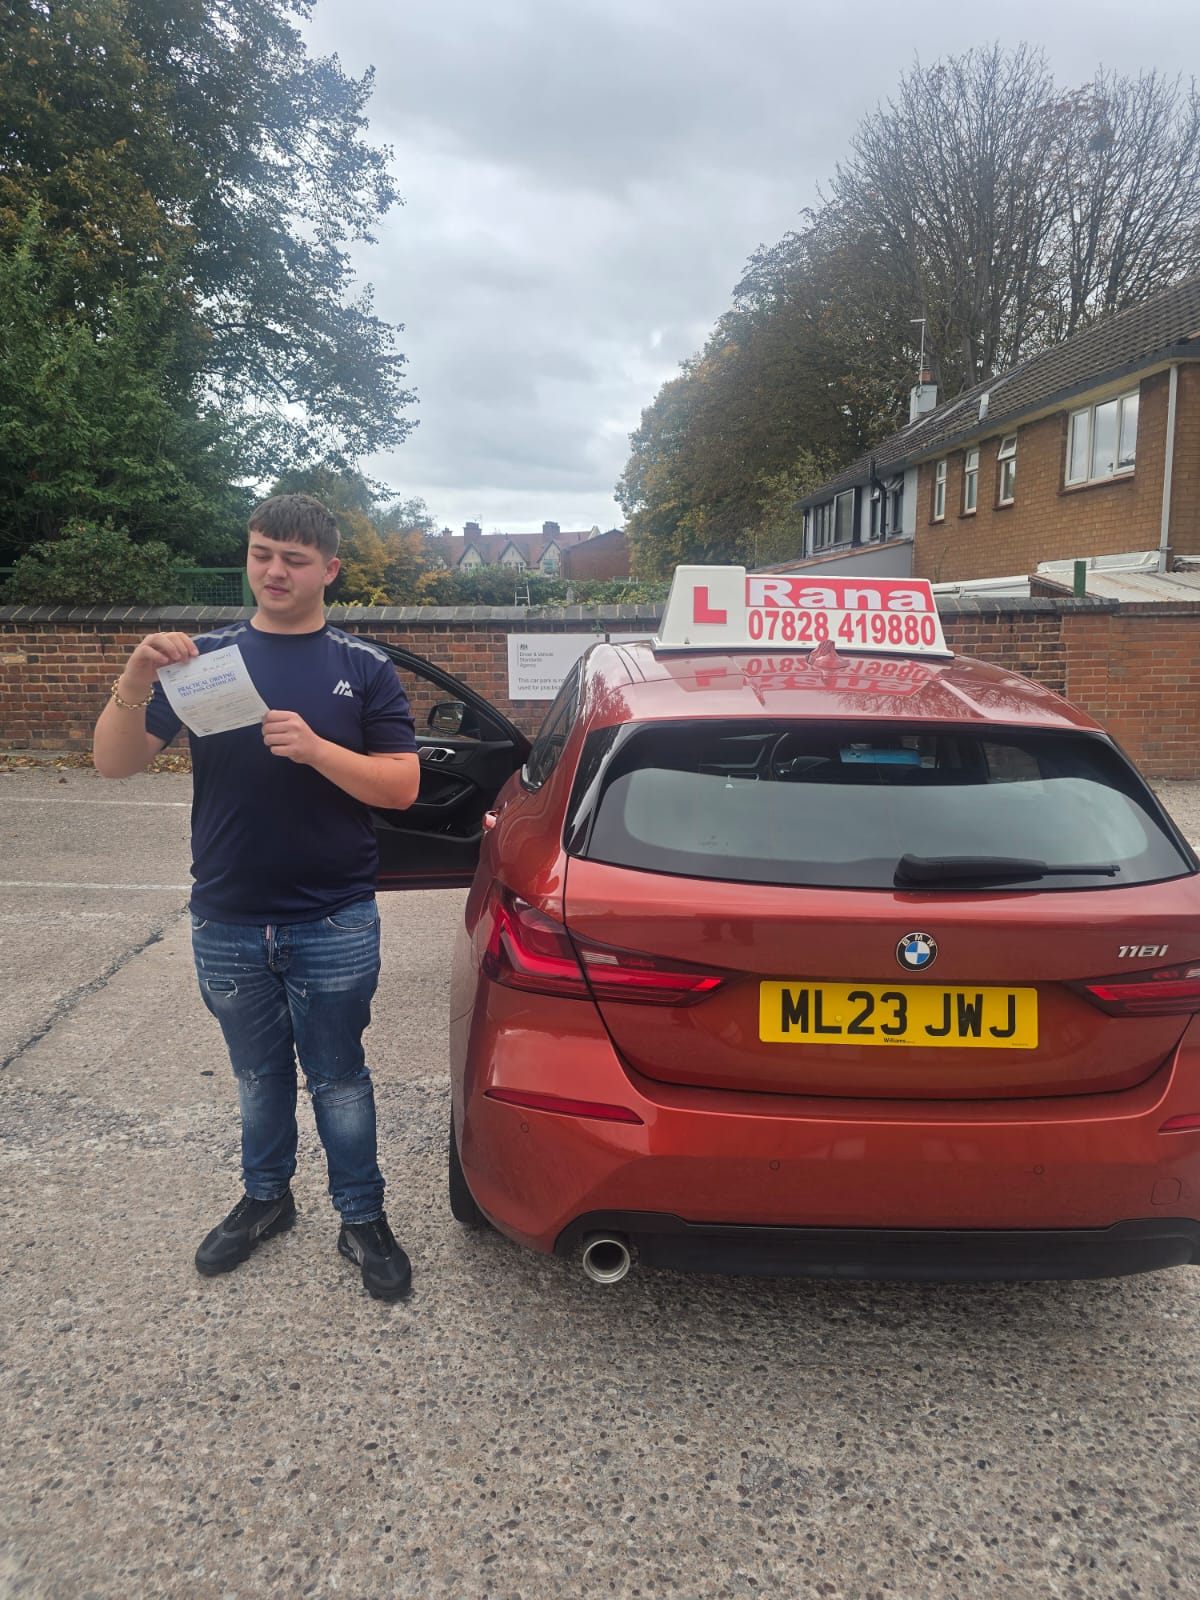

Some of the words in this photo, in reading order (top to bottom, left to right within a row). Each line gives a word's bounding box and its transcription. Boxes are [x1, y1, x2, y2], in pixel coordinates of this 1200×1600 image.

[693, 585, 727, 625] L
[750, 578, 927, 612] Rana
[749, 609, 829, 642] 07828
[838, 612, 936, 646] 419880
[177, 680, 208, 693] PRACTICAL
[209, 671, 236, 684] DRIVING
[781, 988, 908, 1035] ML23
[924, 993, 1016, 1038] JWJ
